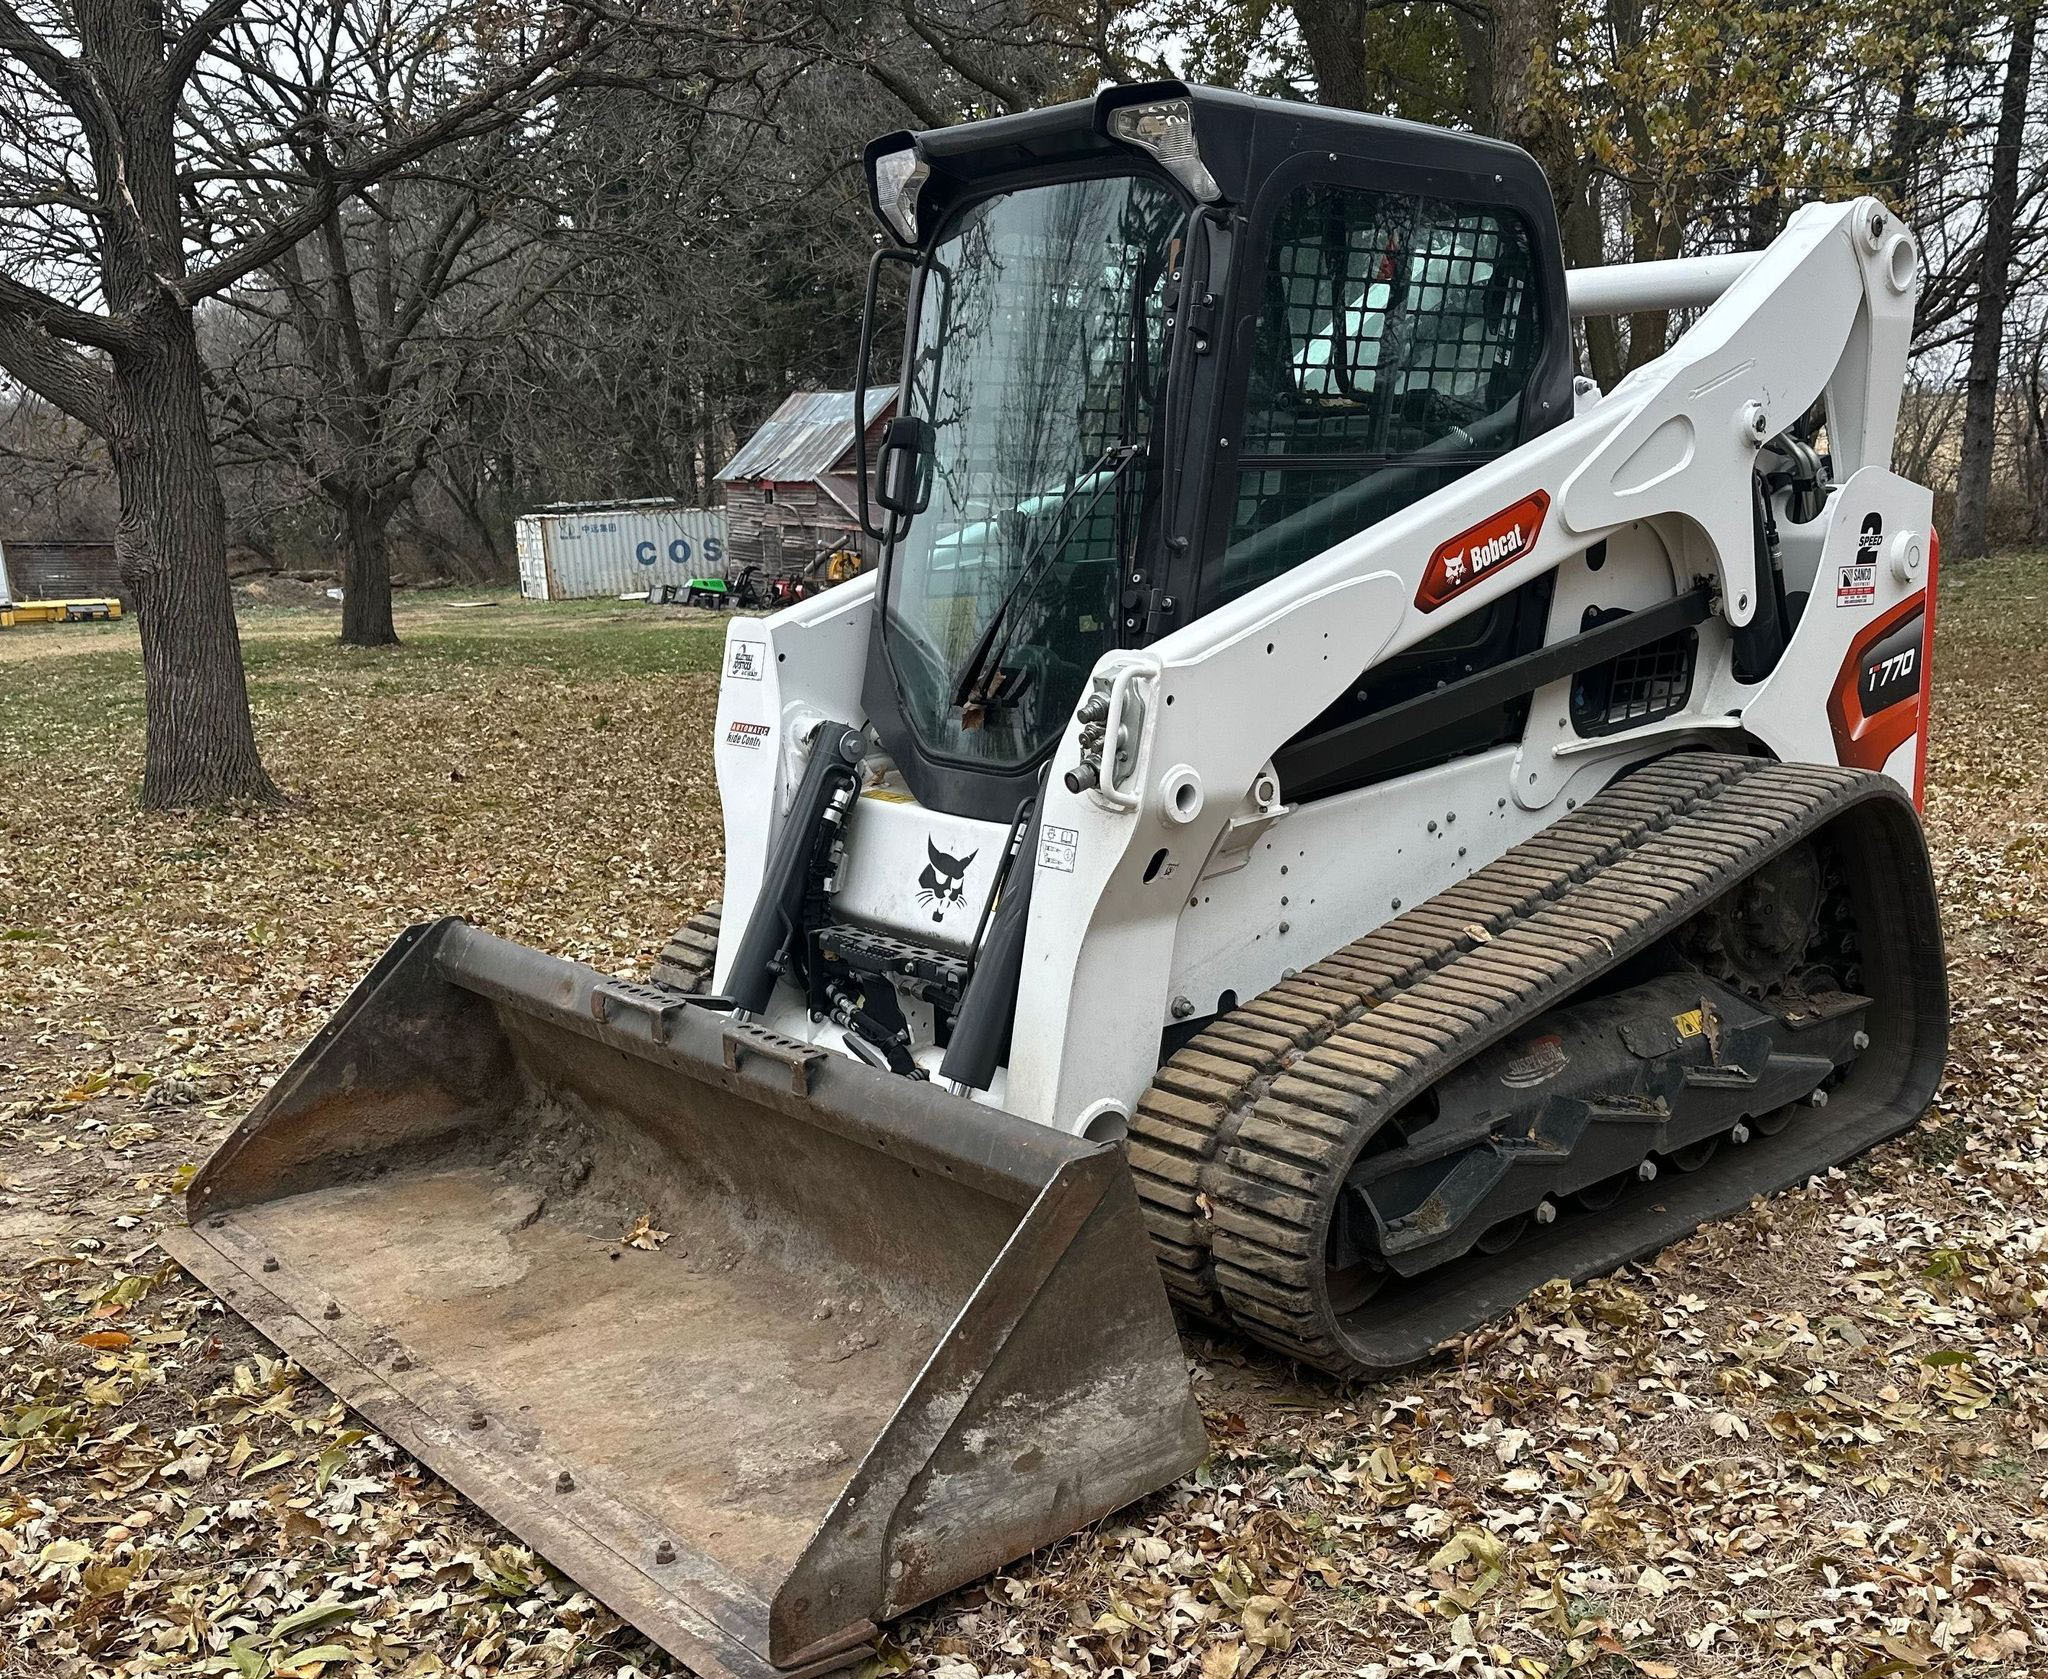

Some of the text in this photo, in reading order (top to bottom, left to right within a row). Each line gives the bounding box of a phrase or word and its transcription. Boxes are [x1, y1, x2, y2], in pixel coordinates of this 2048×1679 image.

[635, 537, 723, 566] COS
[1470, 523, 1522, 573] Bobcat
[1856, 512, 1882, 565] 2
[1858, 535, 1883, 546] SPEED
[1853, 568, 1872, 581] SANCO
[1868, 648, 1915, 691] T770
[731, 722, 769, 736] AUTOMATIC
